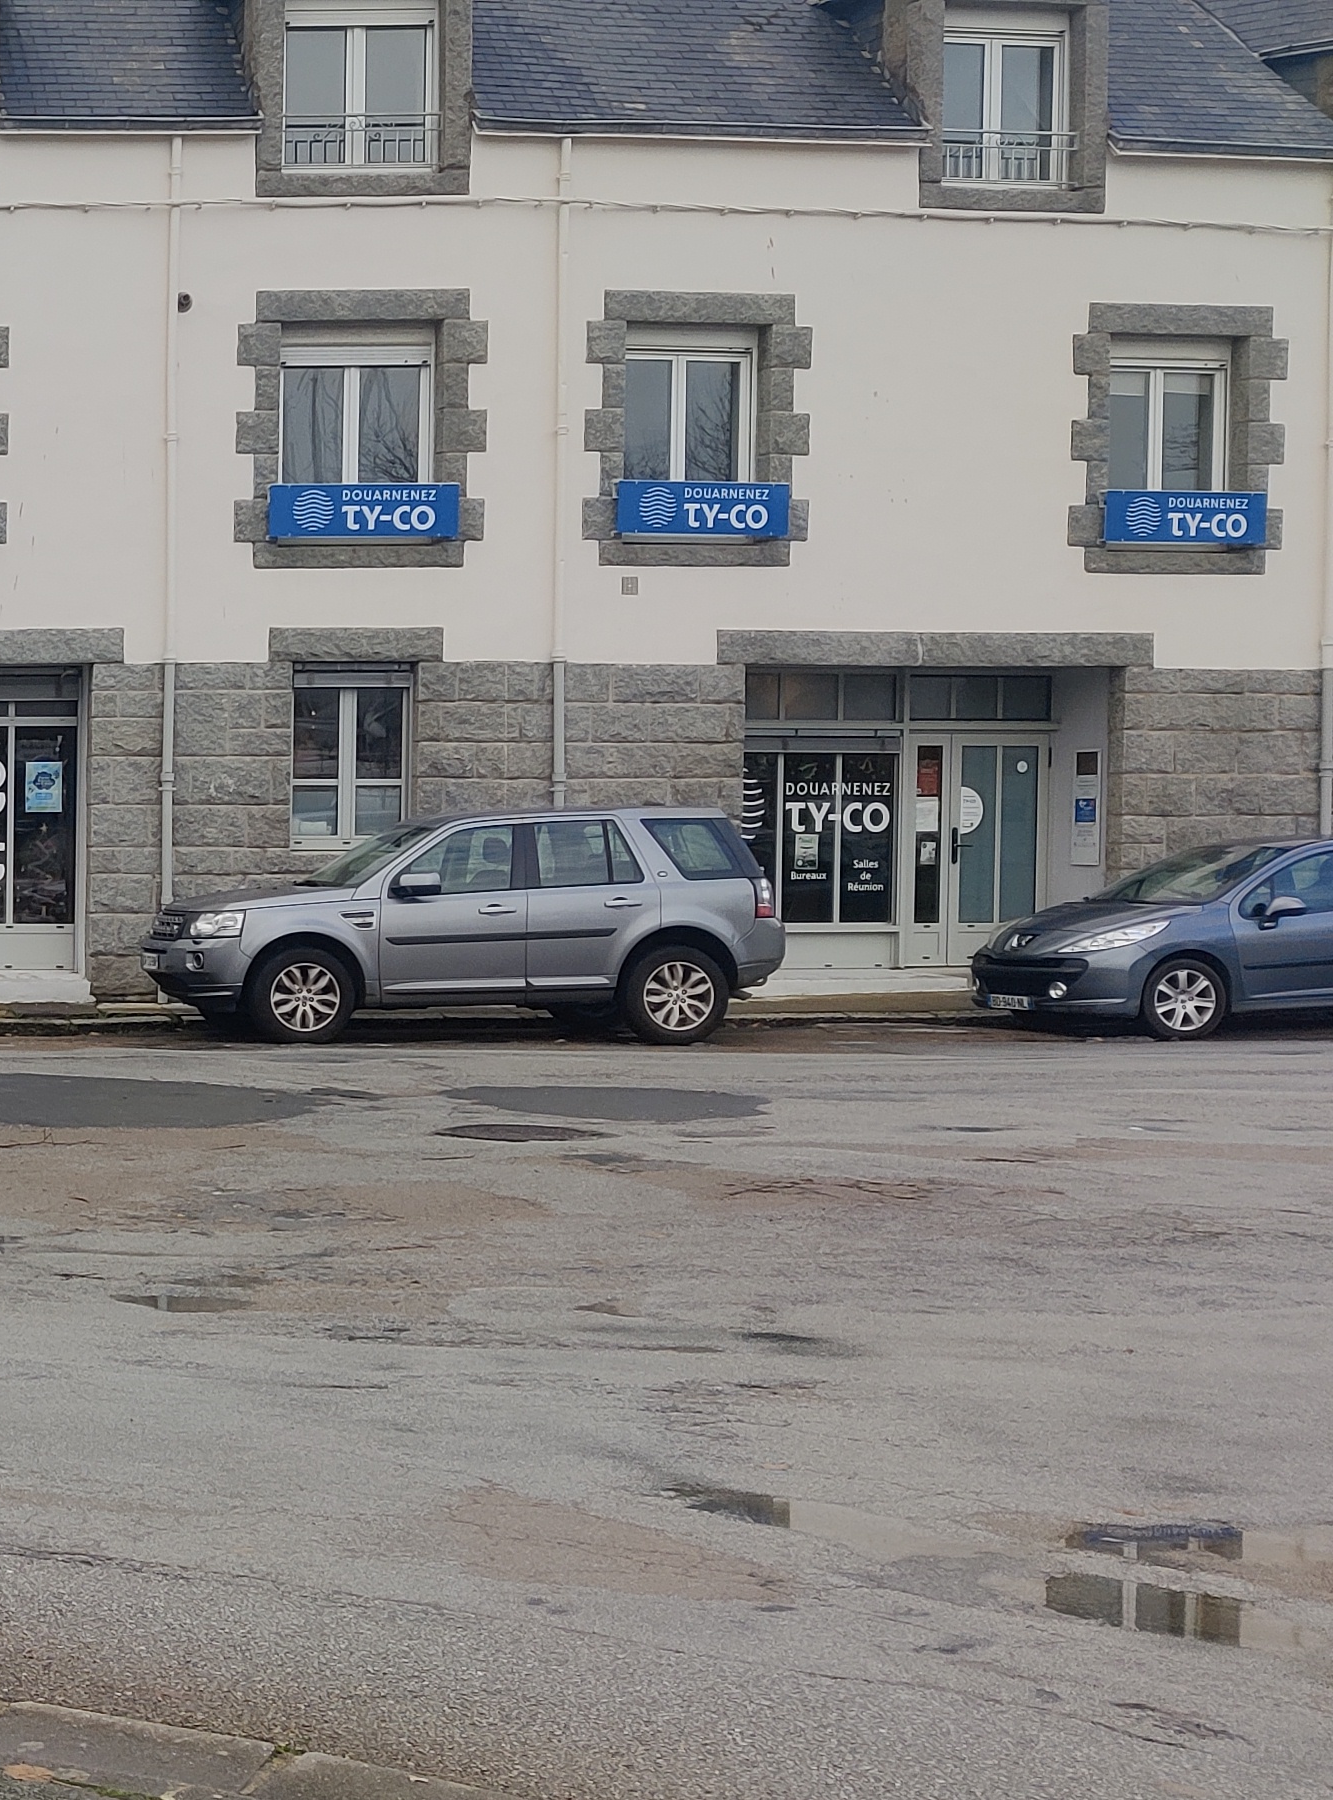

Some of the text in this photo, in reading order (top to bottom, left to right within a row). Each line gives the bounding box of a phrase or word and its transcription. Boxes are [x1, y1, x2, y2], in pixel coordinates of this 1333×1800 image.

[342, 489, 437, 501] DOUARNENEZ
[684, 487, 770, 500] DOUARNENEZ
[1168, 497, 1249, 510] DOUARNENEZ
[341, 505, 436, 531] TY-CO
[683, 503, 769, 530] TY-CO
[1167, 512, 1248, 538] TY-CO
[785, 782, 891, 796] DOUARNENEZ
[785, 802, 890, 833] TY-CO
[852, 859, 879, 869] Salles
[790, 871, 827, 880] Bureaux
[859, 871, 872, 880] de
[847, 882, 884, 892] Réunion
